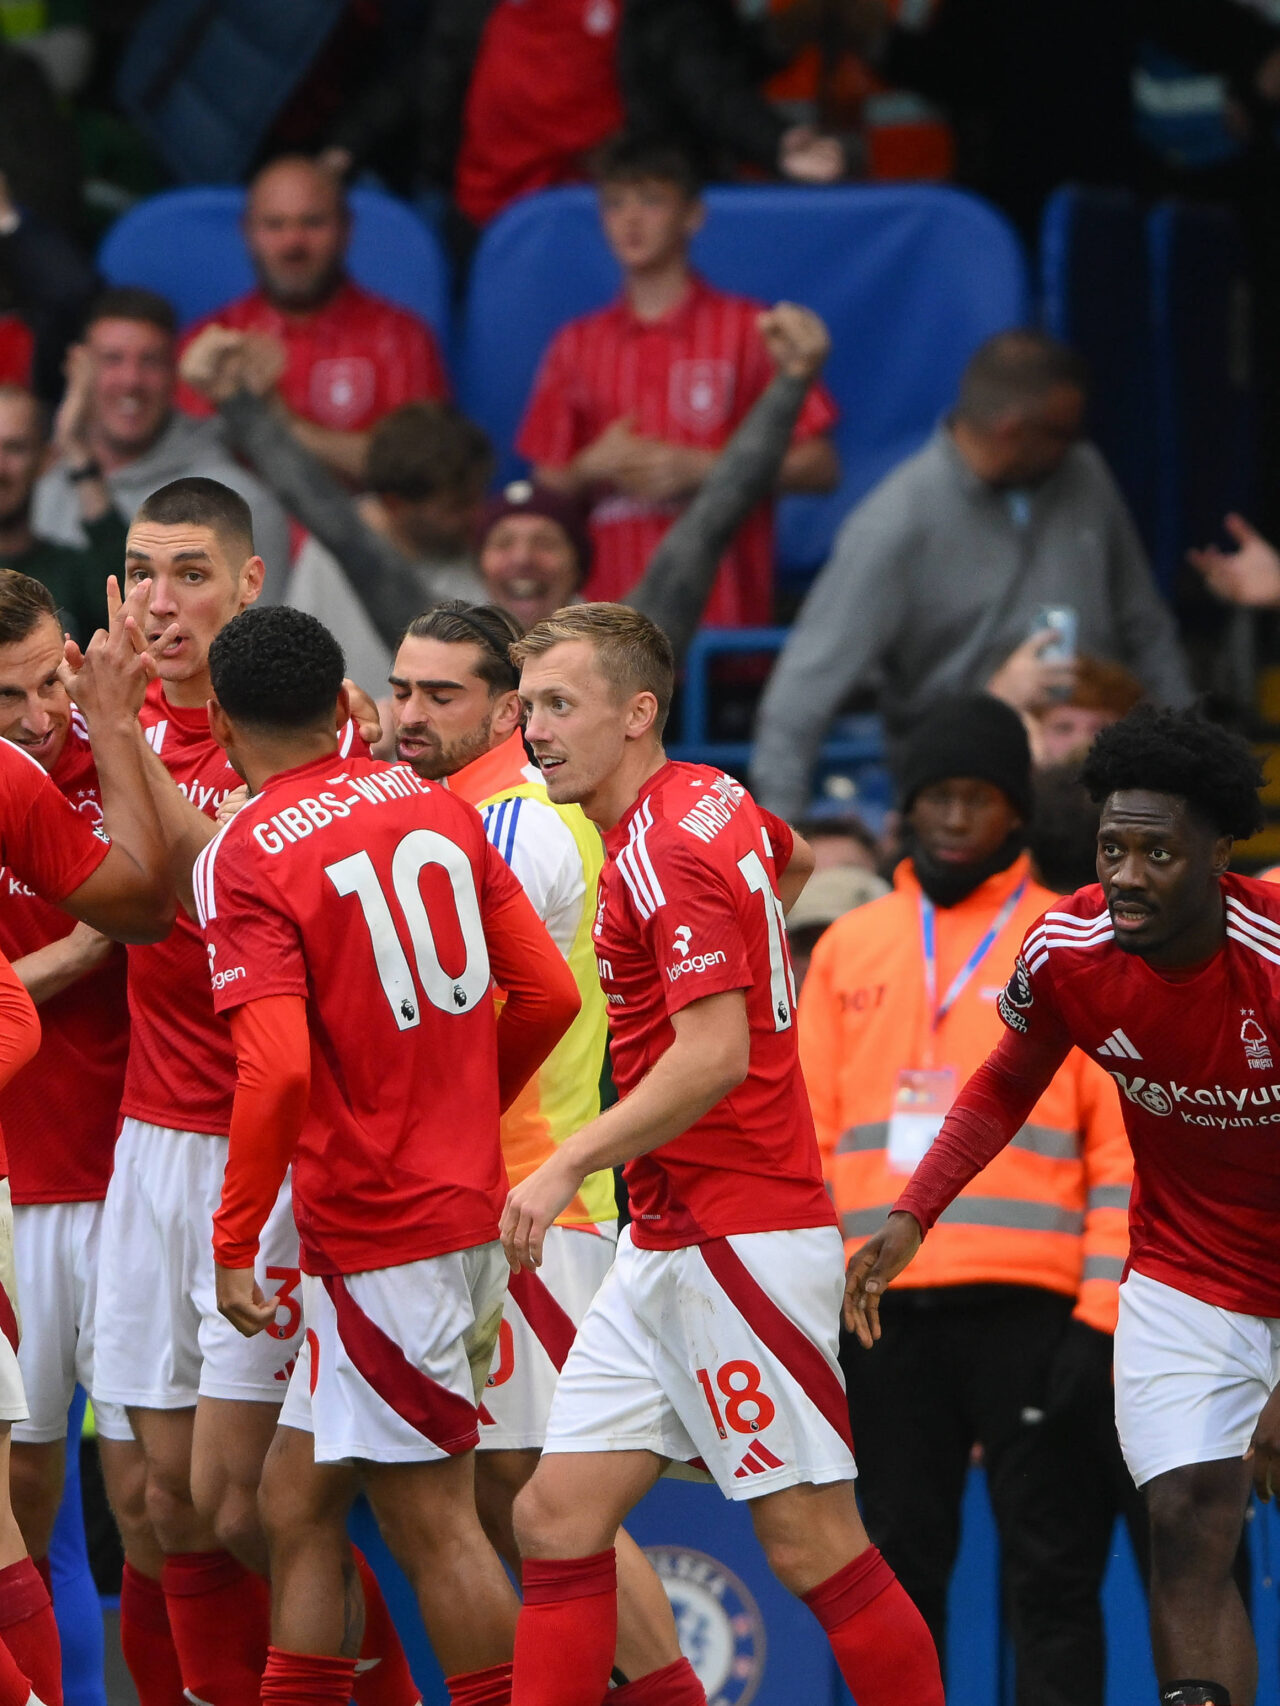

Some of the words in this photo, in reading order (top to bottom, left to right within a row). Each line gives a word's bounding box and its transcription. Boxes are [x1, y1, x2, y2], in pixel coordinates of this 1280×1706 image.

[252, 765, 432, 854] GIBBS-WHITE
[323, 828, 491, 1032] 10
[1180, 1110, 1280, 1130] kaiyun.co
[696, 1359, 776, 1440] 18
